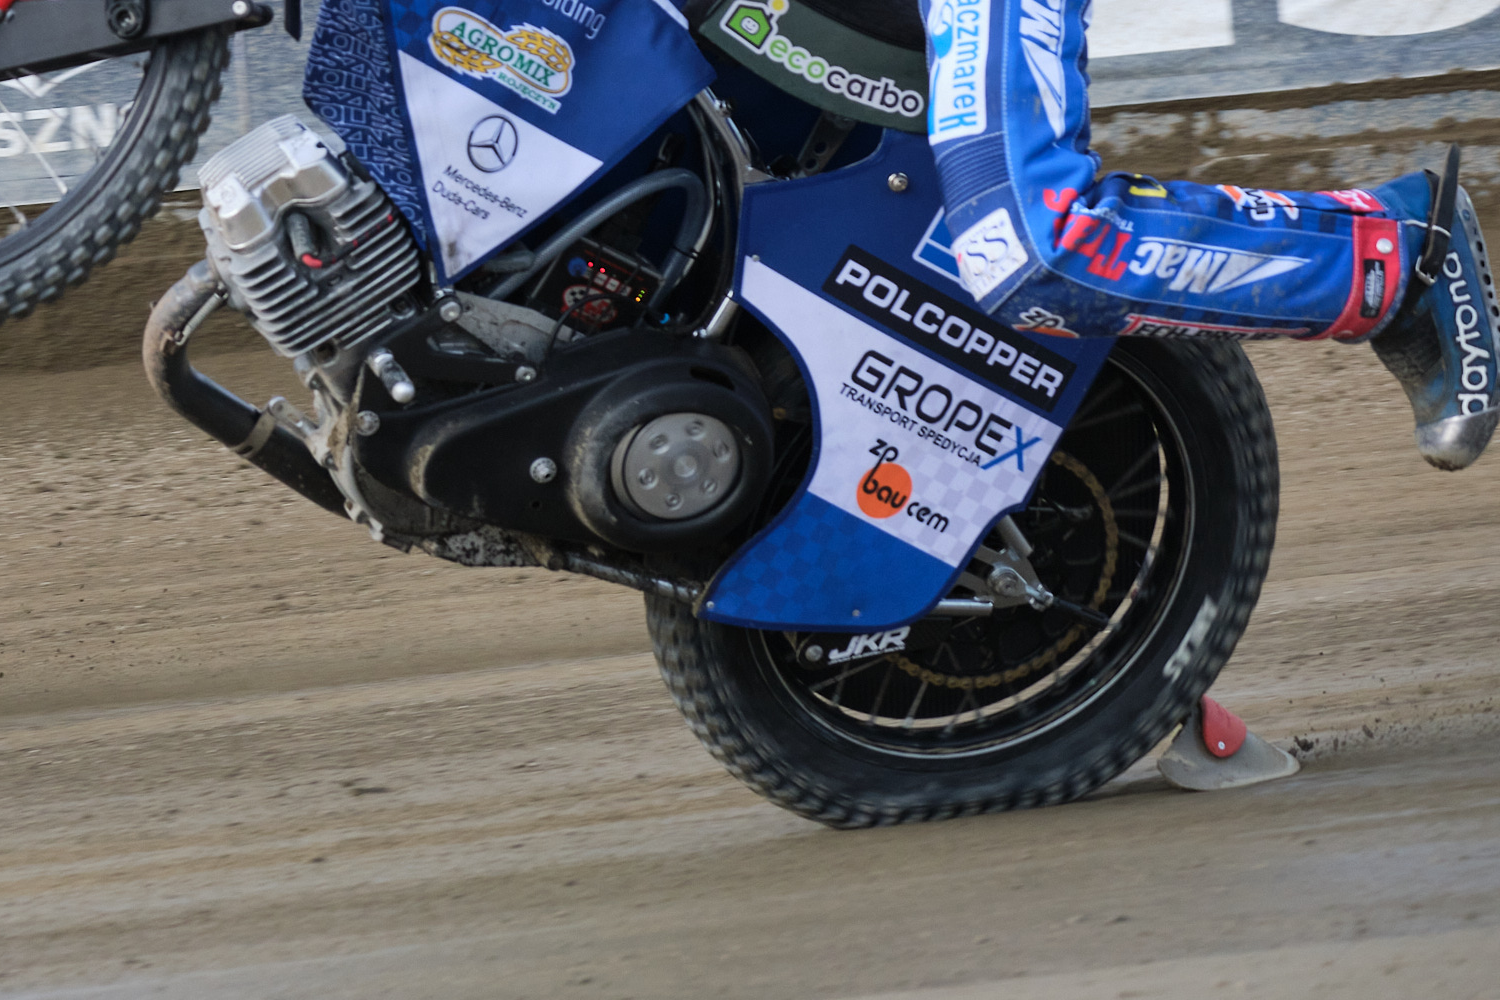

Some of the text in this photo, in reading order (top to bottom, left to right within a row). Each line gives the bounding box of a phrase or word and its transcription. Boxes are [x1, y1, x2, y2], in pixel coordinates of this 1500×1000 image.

[448, 20, 558, 89] AGROMIX
[768, 37, 924, 115] ecocarbo
[431, 181, 492, 222] Duda-Cars
[442, 165, 530, 220] Mercedes-Benz
[1128, 242, 1228, 295] Mac
[835, 258, 1064, 398] POLCOPPER
[1442, 251, 1491, 417] daytona
[839, 382, 981, 468] TRANSPORT SPEDYCJA
[850, 348, 1043, 473] GROPEX
[861, 468, 951, 534] bau cem
[828, 626, 910, 660] JKR
